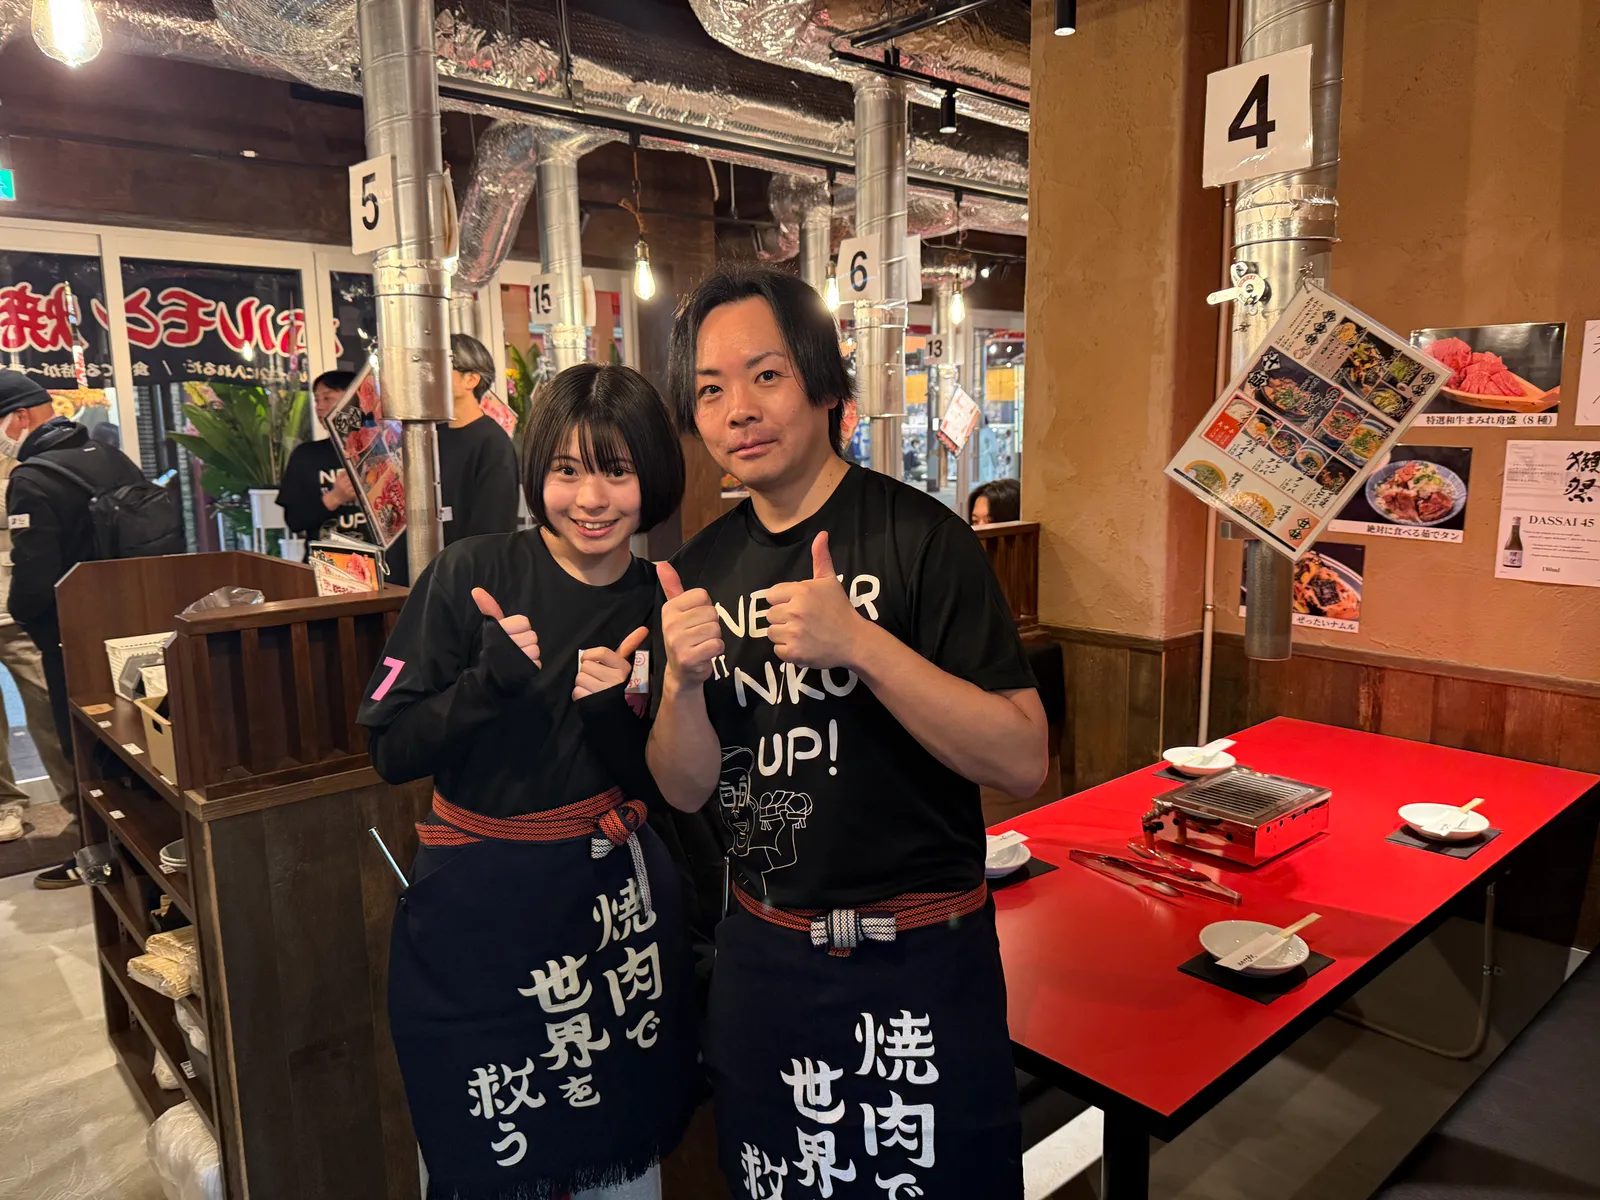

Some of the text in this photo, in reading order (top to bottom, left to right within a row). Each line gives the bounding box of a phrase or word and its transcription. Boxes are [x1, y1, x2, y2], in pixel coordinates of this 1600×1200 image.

[1227, 73, 1276, 150] 4
[361, 172, 380, 231] 5
[533, 283, 552, 314] 15
[849, 250, 869, 292] 6
[927, 339, 943, 358] 13
[1529, 515, 1595, 528] DASSAI 45
[714, 574, 881, 639] NER
[1296, 616, 1356, 630] ぜったいナムル
[370, 656, 406, 702] 7
[757, 719, 839, 777] UP!
[592, 877, 663, 1048] 焼肉で
[517, 954, 611, 1108] 世界を
[467, 1057, 547, 1167] 救う
